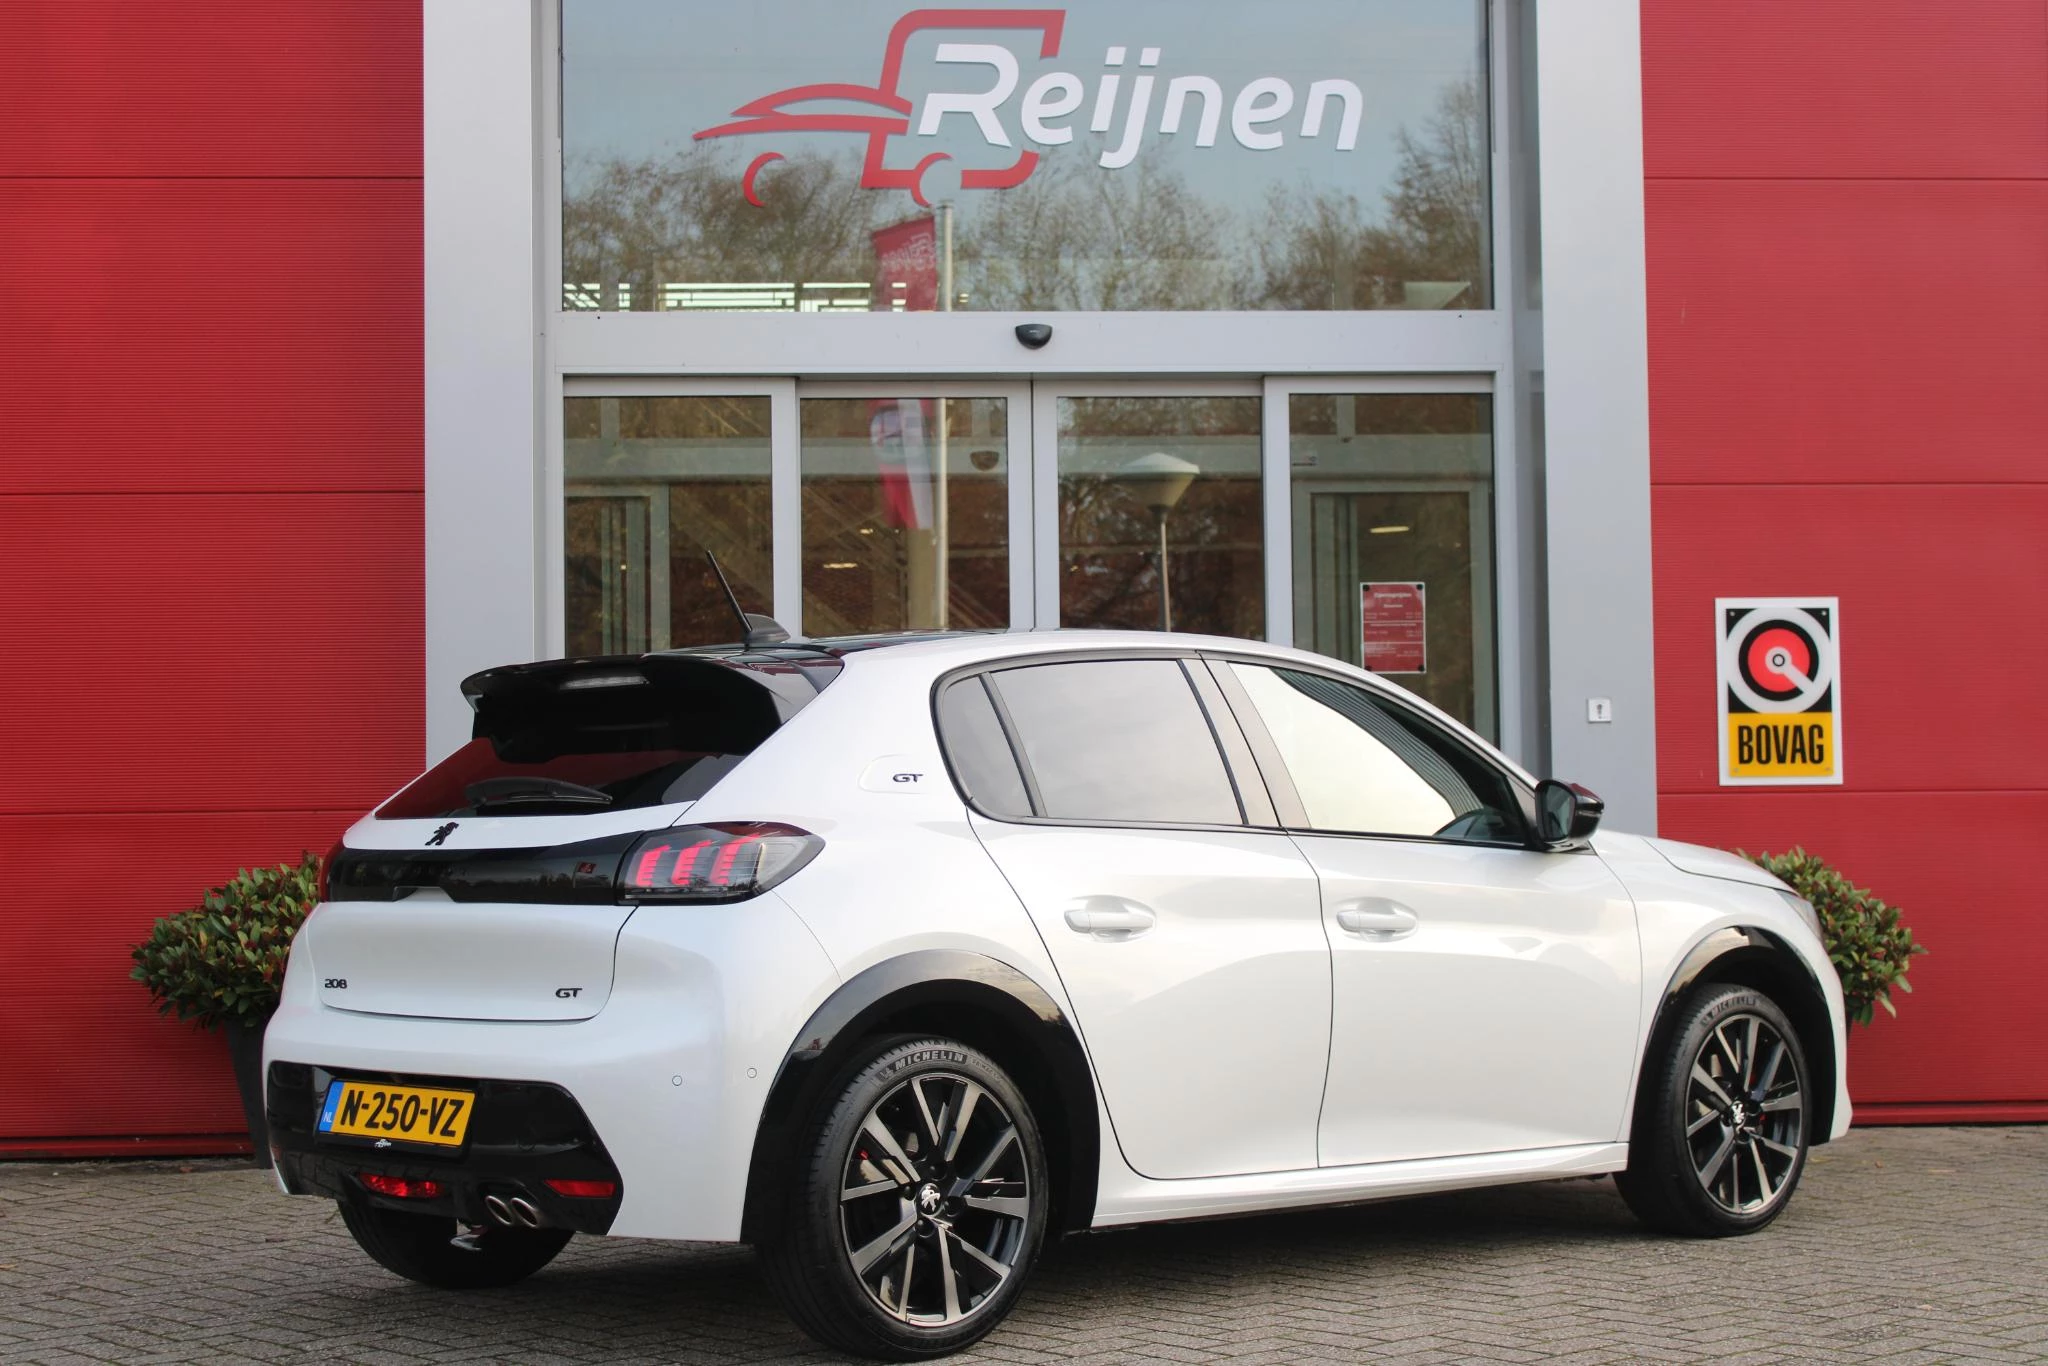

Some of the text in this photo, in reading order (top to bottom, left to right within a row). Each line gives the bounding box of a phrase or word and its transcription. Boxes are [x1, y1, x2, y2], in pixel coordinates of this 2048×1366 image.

[918, 44, 1363, 169] Reijnen
[1738, 725, 1824, 765] BOVAG
[893, 773, 924, 783] GT
[324, 978, 348, 989] 208
[555, 987, 583, 998] GT
[895, 1050, 964, 1070] MICHELIN
[322, 1089, 465, 1138] NL N-250-VZ
